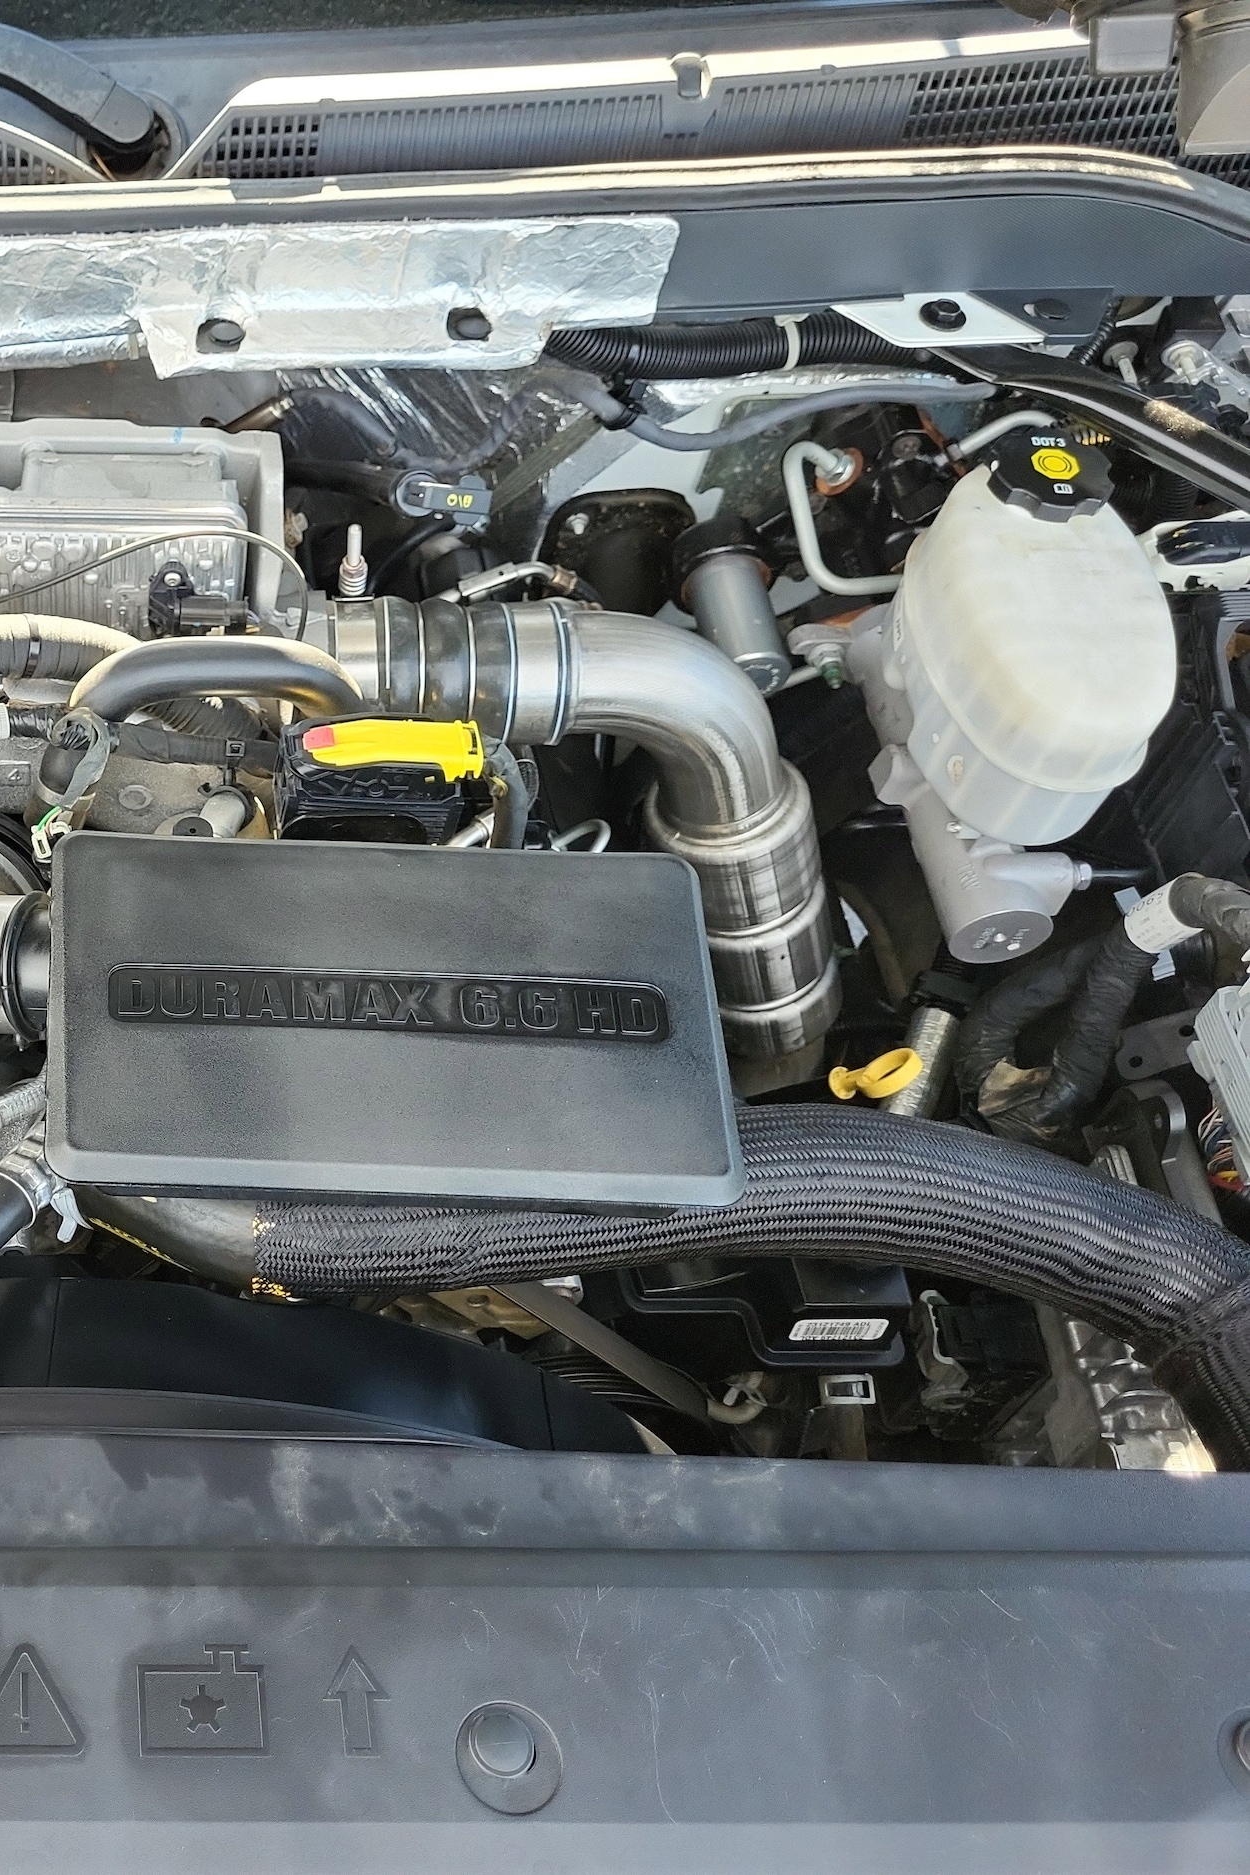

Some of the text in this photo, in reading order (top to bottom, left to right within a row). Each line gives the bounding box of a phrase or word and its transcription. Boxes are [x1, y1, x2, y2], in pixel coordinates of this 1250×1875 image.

[1031, 435, 1066, 448] DOT 3
[117, 973, 661, 1036] DURAMAX 6.6 HD
